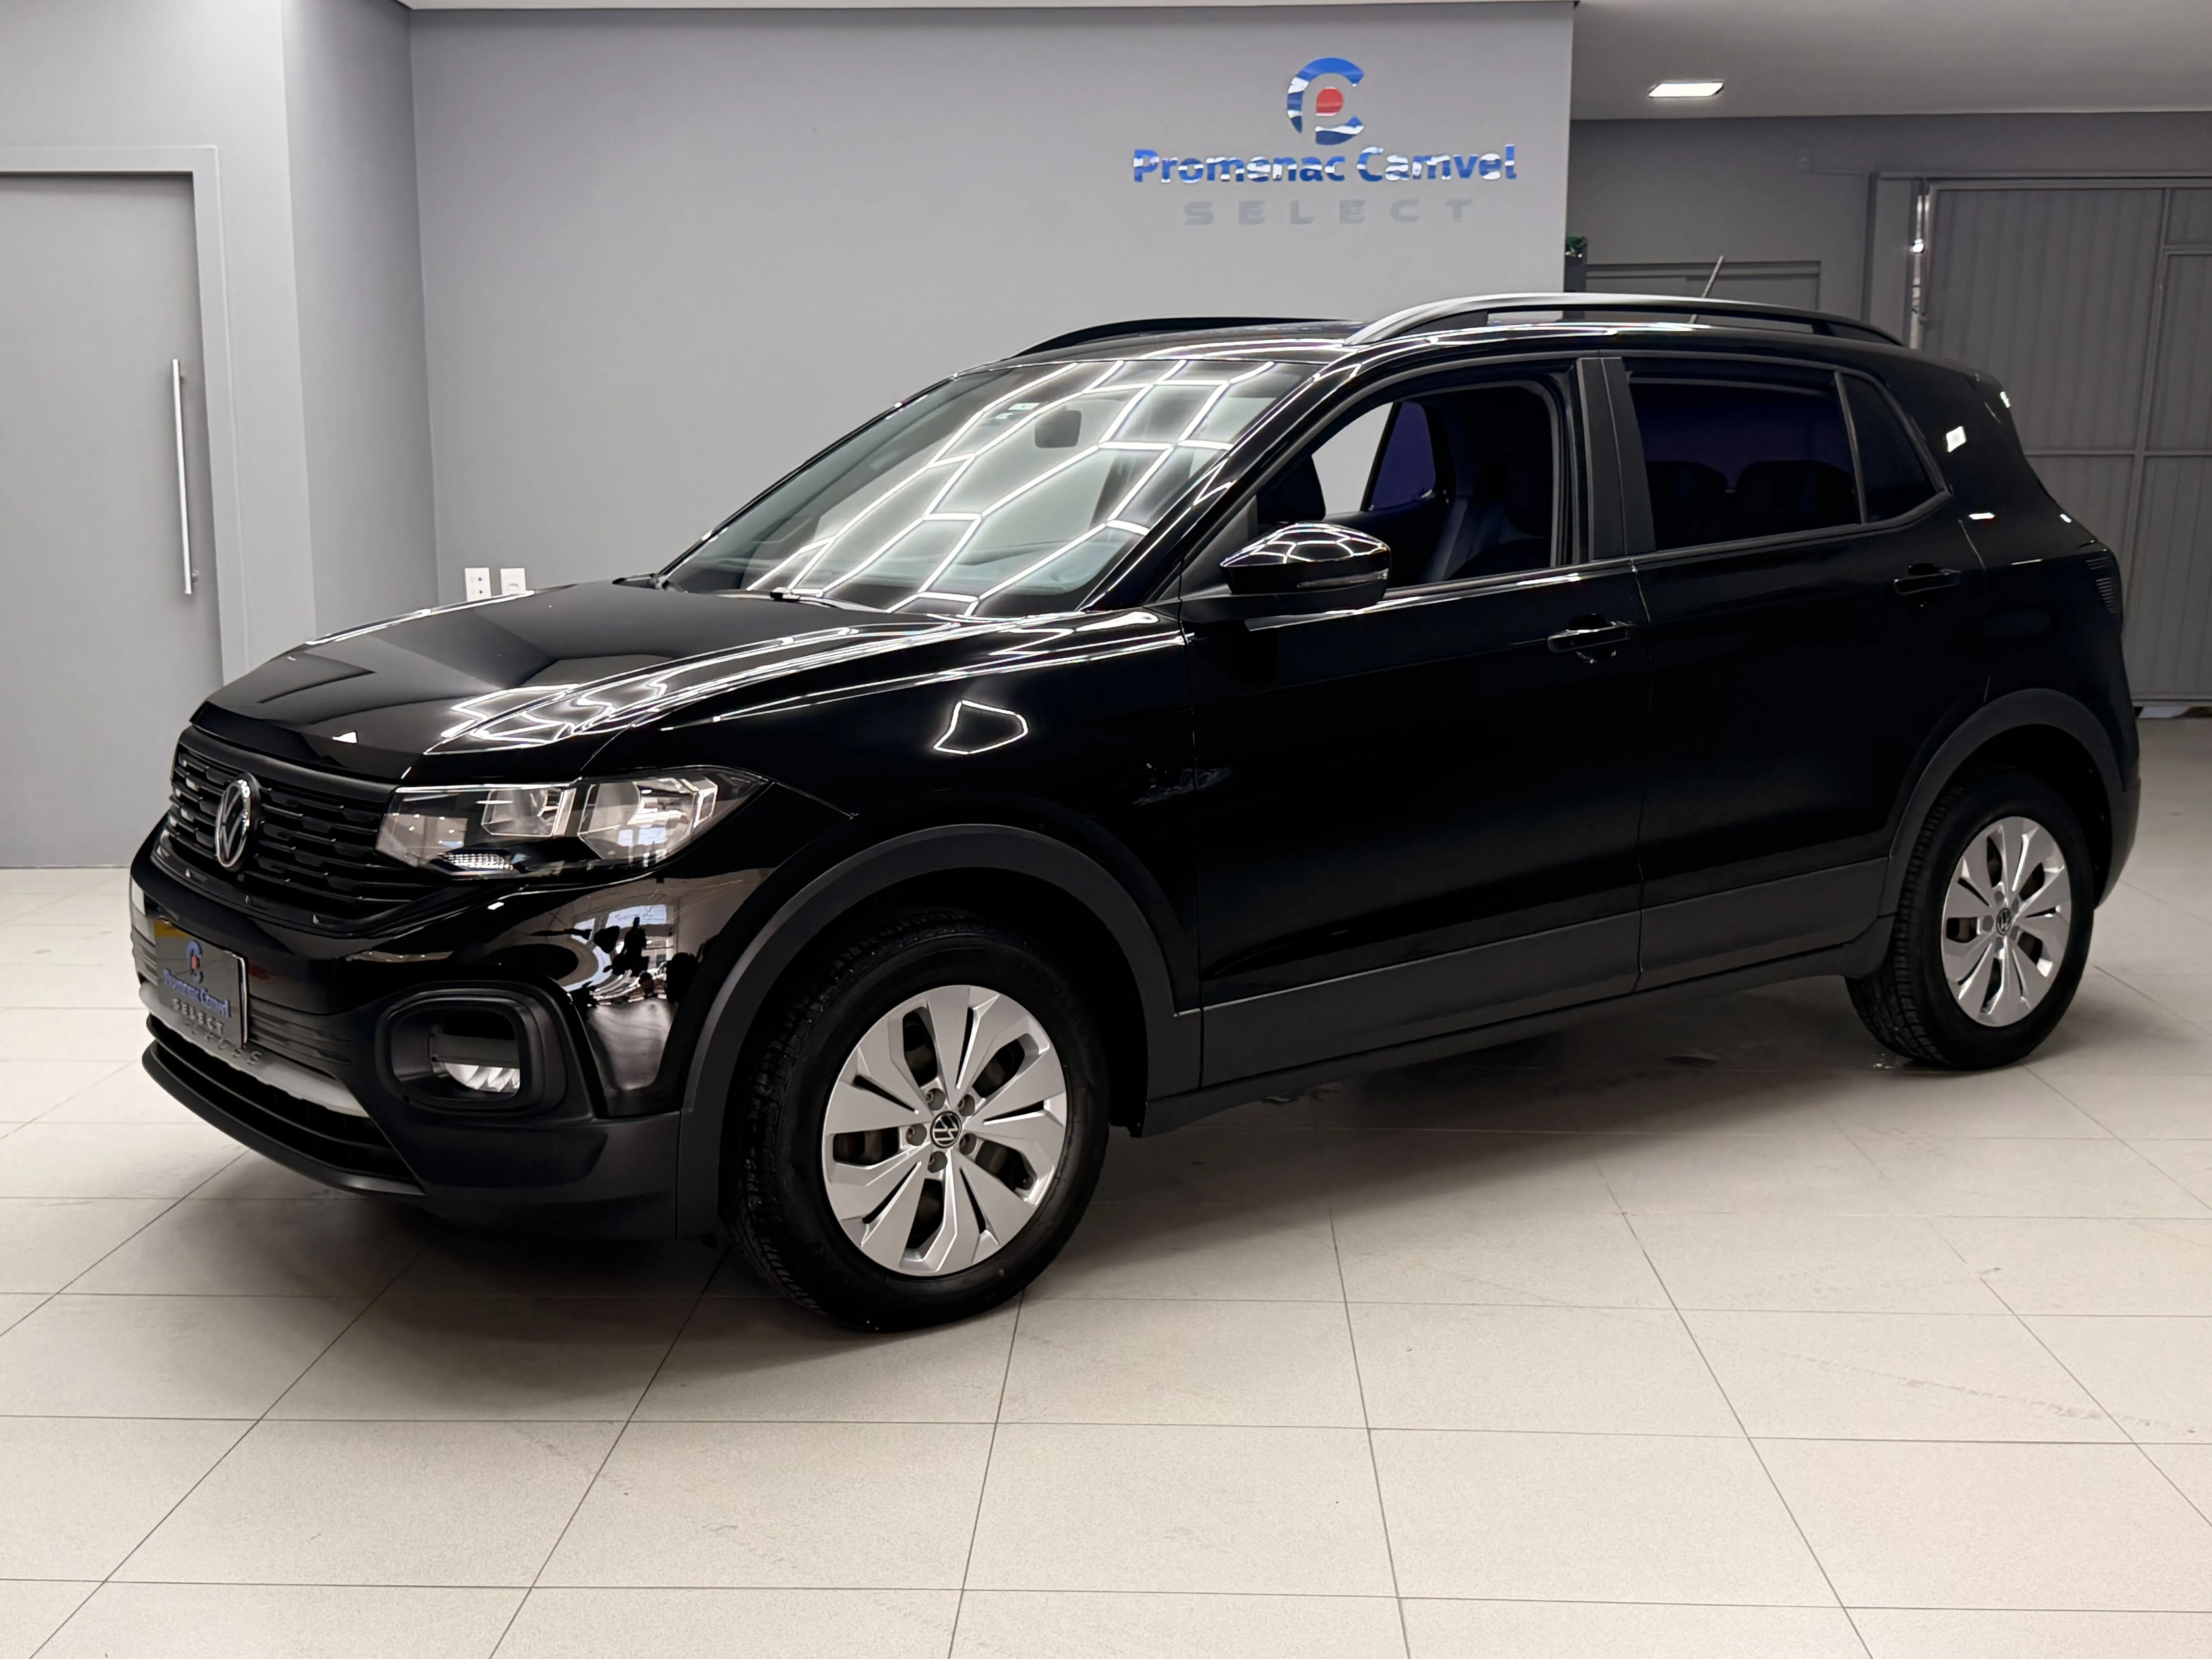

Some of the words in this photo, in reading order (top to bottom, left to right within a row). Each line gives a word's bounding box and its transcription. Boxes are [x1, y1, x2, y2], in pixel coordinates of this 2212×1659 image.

[1133, 149, 1345, 183] Promenac
[1357, 144, 1517, 182] Camvel
[1183, 198, 1473, 226] SELECT
[173, 998, 225, 1035] SELECT
